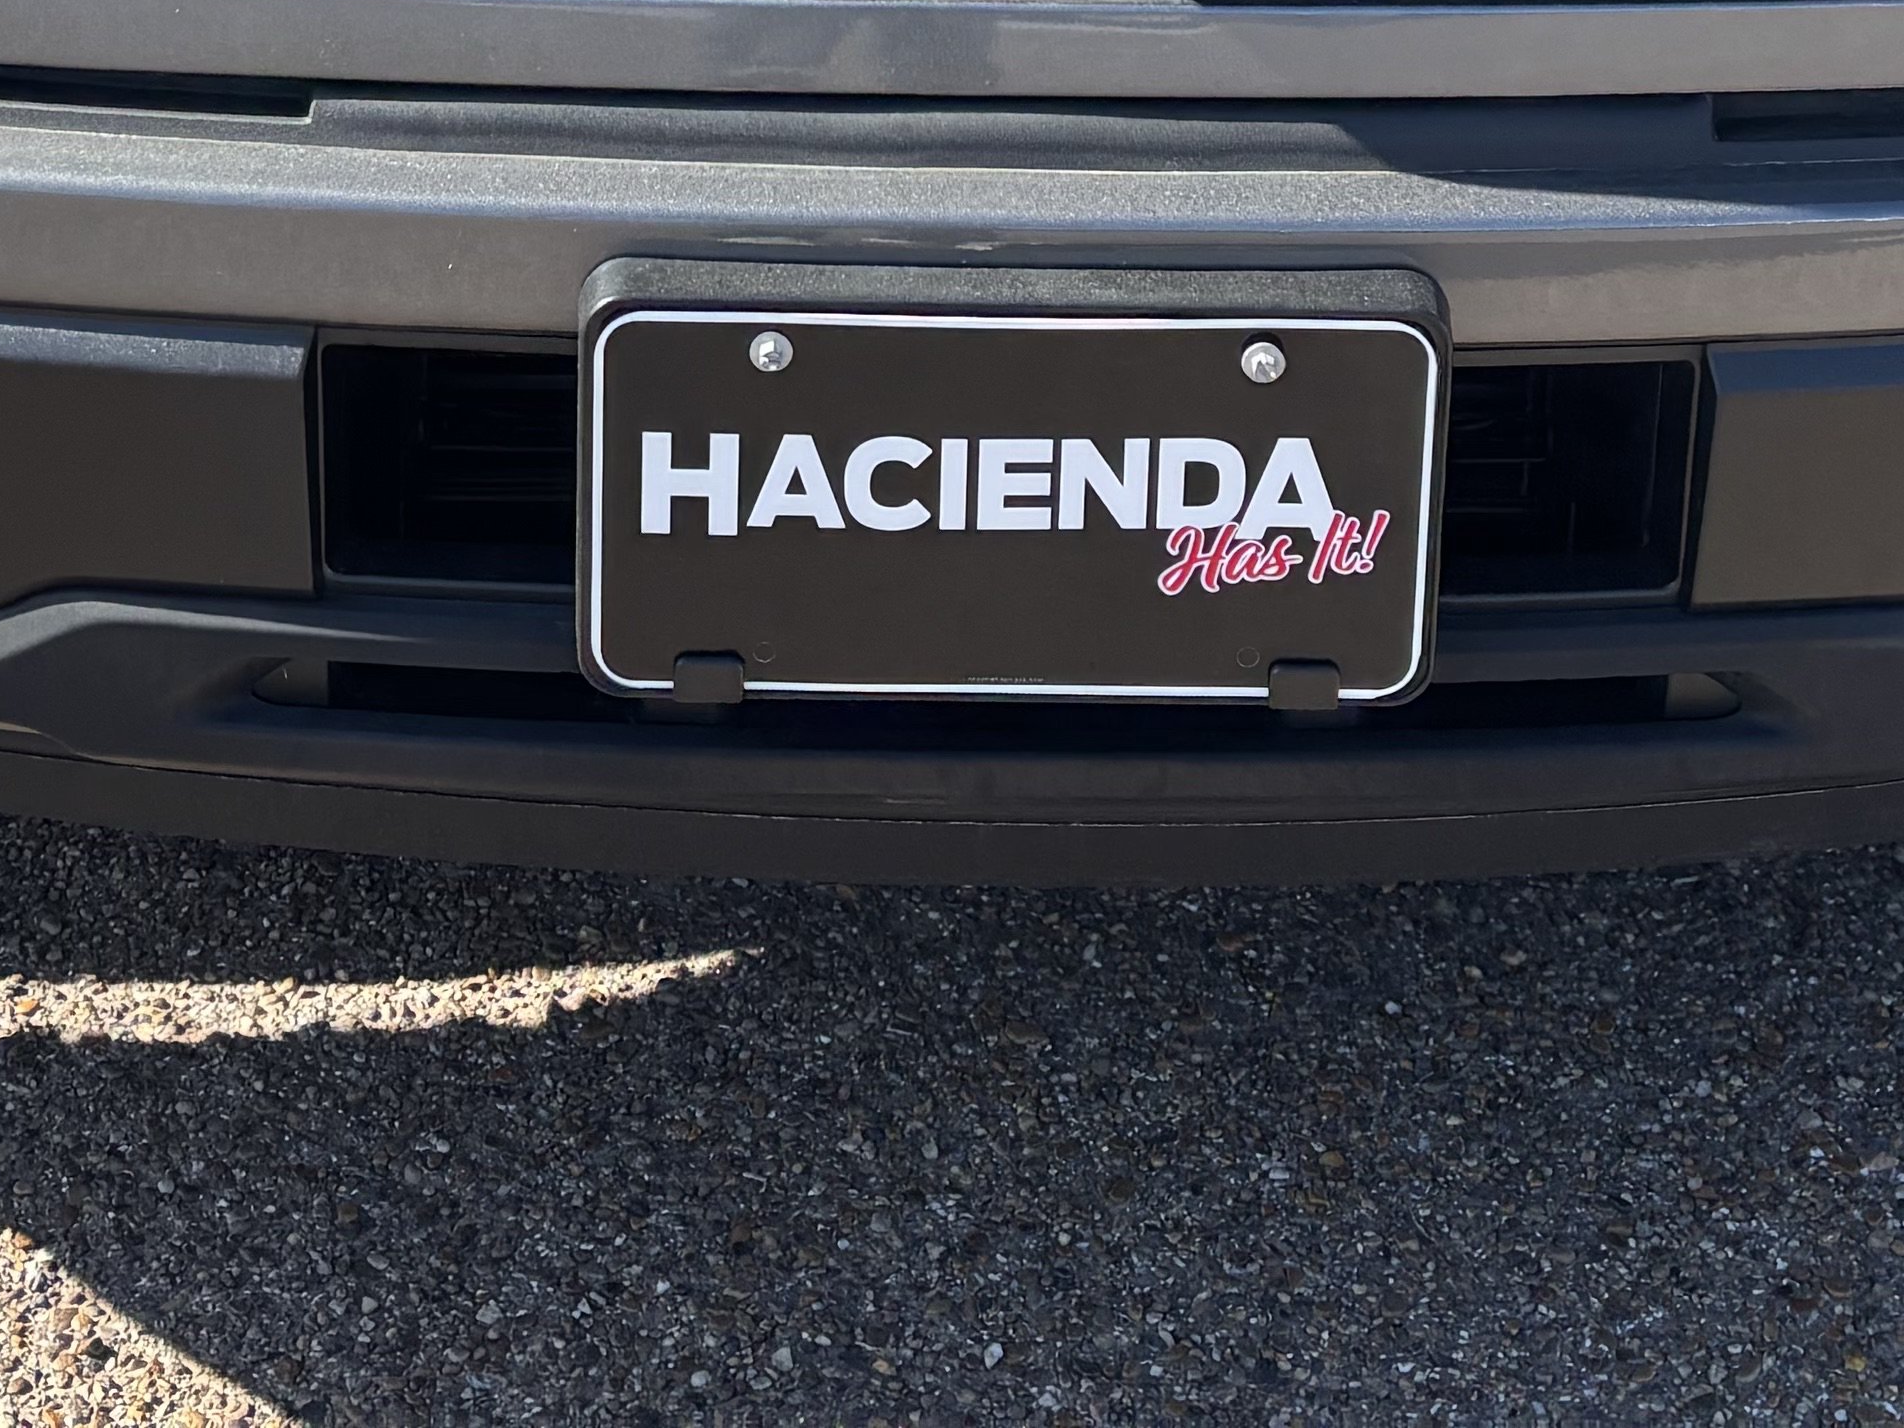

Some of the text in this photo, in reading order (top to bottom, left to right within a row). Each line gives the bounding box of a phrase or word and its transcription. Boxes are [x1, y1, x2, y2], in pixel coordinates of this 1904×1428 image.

[640, 432, 1332, 541] HACIENDA
[1157, 509, 1391, 596] Has It!
